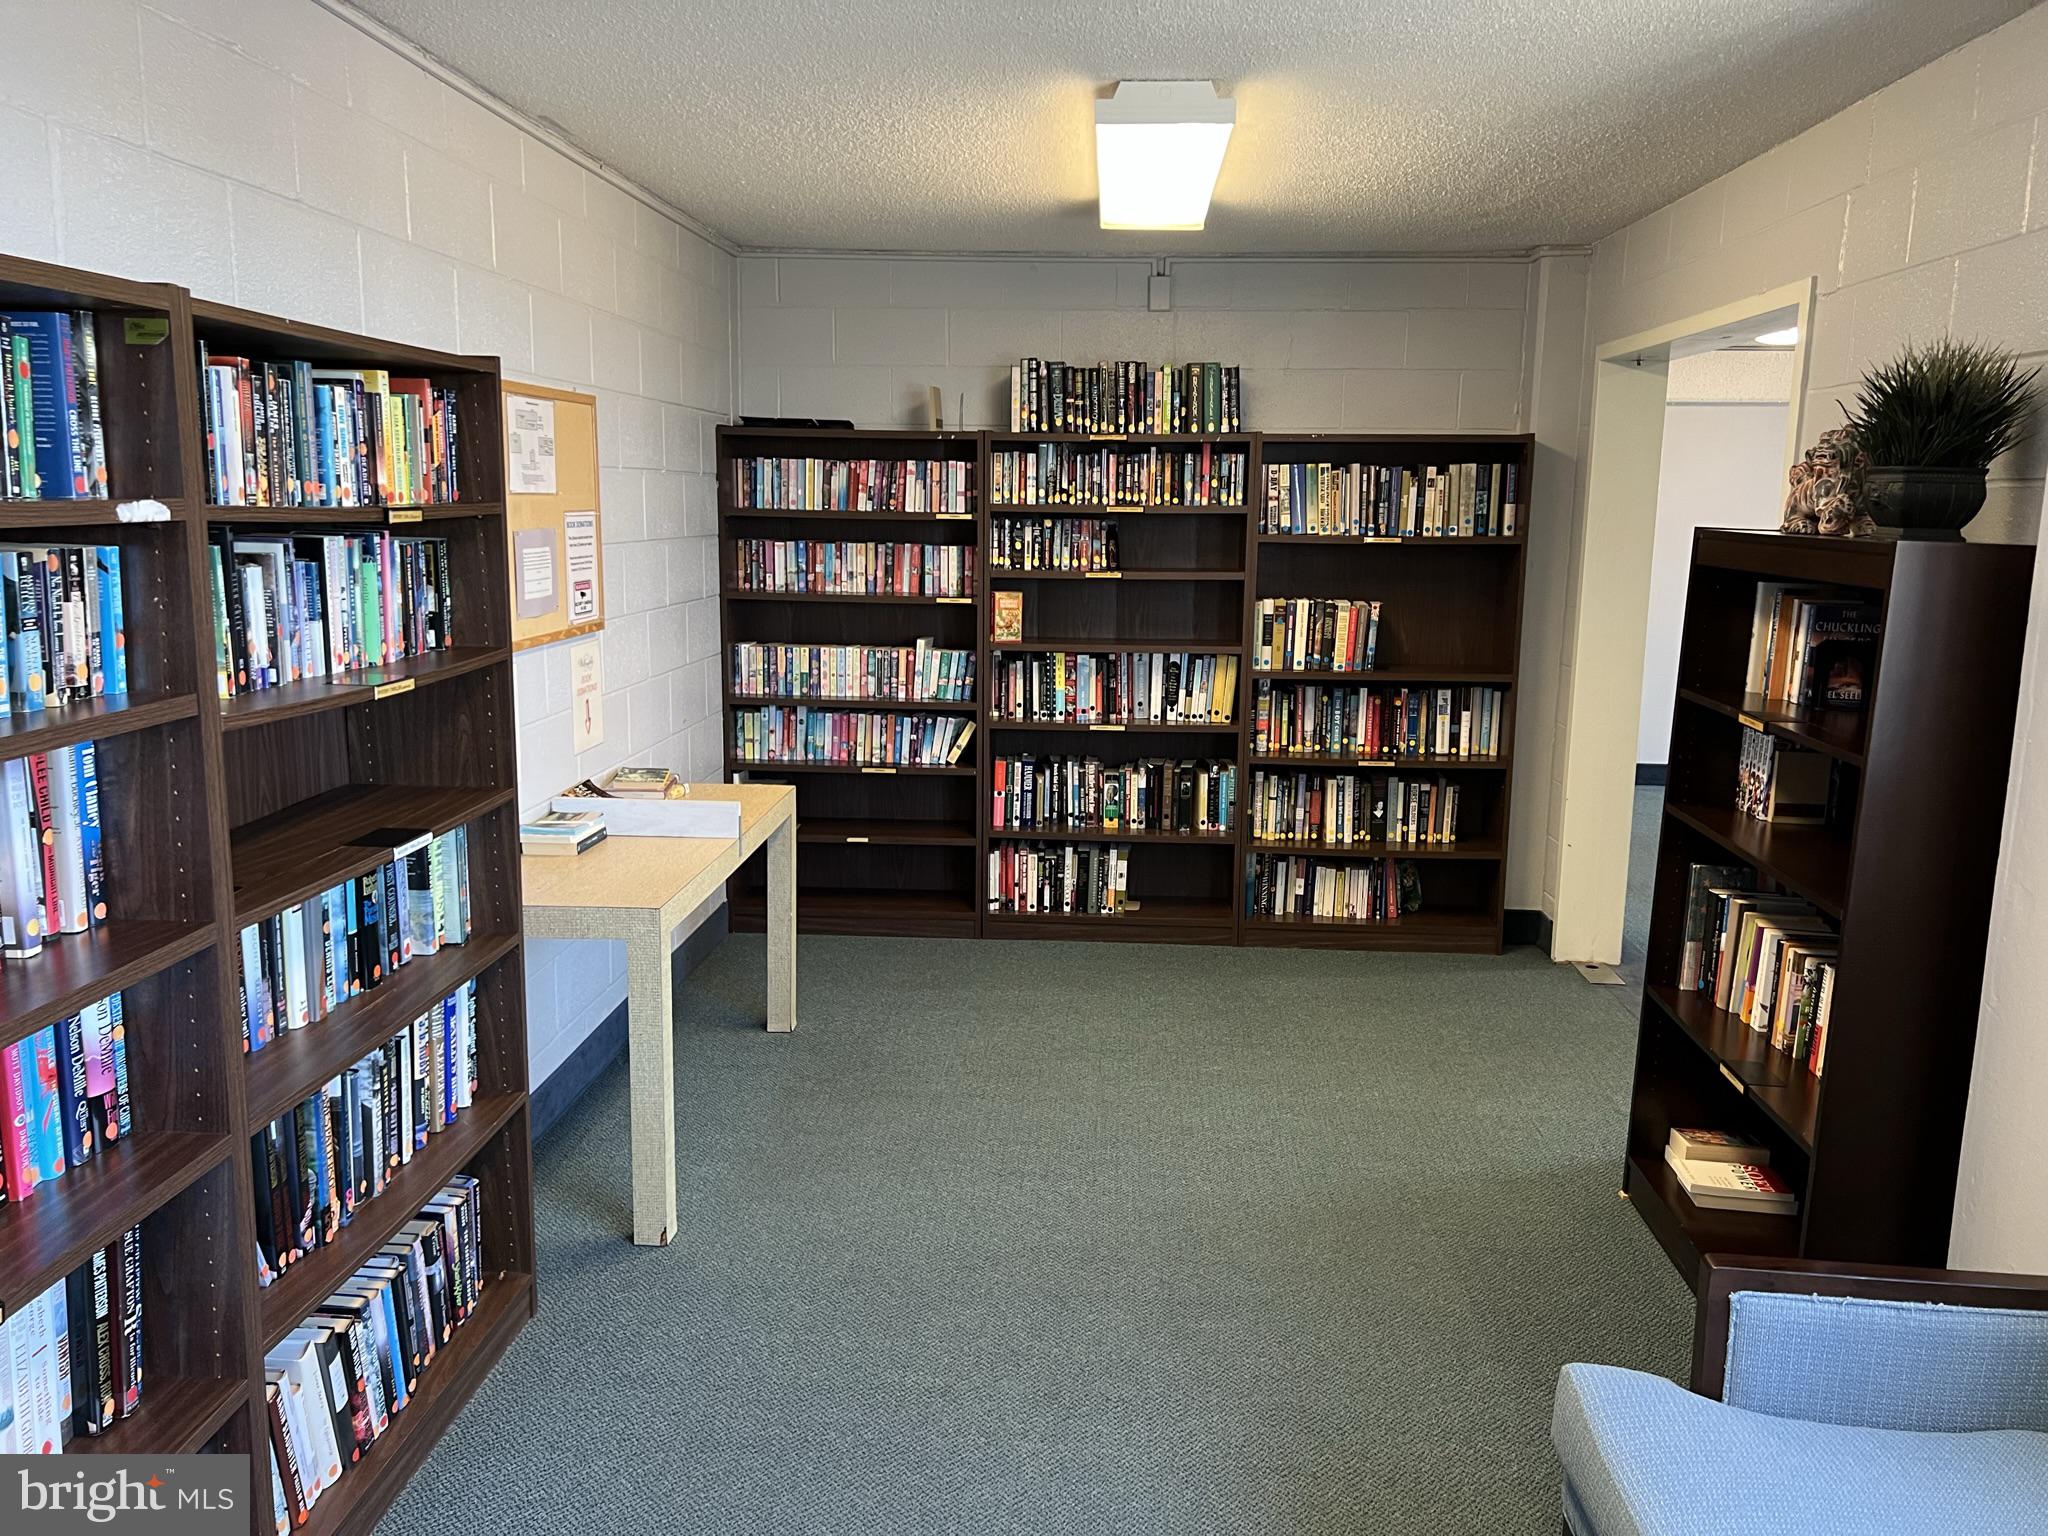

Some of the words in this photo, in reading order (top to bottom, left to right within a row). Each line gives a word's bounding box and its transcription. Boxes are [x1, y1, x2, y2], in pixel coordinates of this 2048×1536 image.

[65, 363, 77, 404] PATTERSON
[68, 409, 79, 437] CROSS
[272, 400, 280, 428] JAMES
[71, 437, 81, 452] THE
[72, 455, 82, 473] LINE
[361, 457, 369, 496] DEADLINE
[28, 575, 37, 609] MATTHEW
[52, 589, 63, 610] Night
[1815, 621, 1880, 634] CHUCKLING
[1842, 610, 1857, 619] THE
[36, 760, 47, 784] LEE
[81, 744, 95, 778] Tom
[39, 785, 51, 823] CHILD
[82, 780, 100, 828] Clancy
[1411, 785, 1419, 804] HORSE
[48, 854, 58, 894] MIDNIGHT
[87, 858, 104, 896] Tiger
[386, 863, 395, 887] FIRST
[51, 895, 59, 914] LINE
[386, 887, 396, 927] COUNSEL
[1261, 876, 1269, 908] WINNING
[324, 940, 333, 974] DENNIS
[112, 998, 122, 1028] DEXTER
[239, 987, 248, 1017] ashley
[68, 1015, 81, 1054] Nelson
[241, 1018, 250, 1039] bell
[11, 1048, 20, 1070] MOTT
[98, 1023, 115, 1076] DeMille
[71, 1054, 87, 1098] DeMille
[115, 1051, 128, 1094] DAUGHTERS
[436, 1042, 445, 1092] SLEEPER
[12, 1072, 24, 1112] DAVIDSON
[119, 1094, 129, 1106] OF
[120, 1105, 131, 1126] CAIN
[19, 1129, 27, 1151] DARK
[123, 1230, 134, 1256] SUE
[94, 1272, 108, 1320] PATTERSON
[124, 1256, 136, 1315] GRAFTON
[453, 1285, 463, 1307] River
[28, 1303, 37, 1337] eorge
[37, 1299, 48, 1338] zabeth
[124, 1314, 138, 1337] R
[96, 1321, 109, 1348] ALEX
[129, 1332, 136, 1342] is
[129, 1343, 137, 1356] for
[348, 1324, 358, 1349] BRAD
[57, 1334, 71, 1381] VANISH
[98, 1345, 110, 1384] CROSS,
[351, 1349, 363, 1380] TAYLOR
[15, 1344, 30, 1419] ELIZABETH
[35, 1376, 41, 1386] to
[41, 1360, 53, 1425] Something
[36, 1393, 44, 1421] Hide
[276, 1395, 286, 1425] KARIN
[282, 1423, 297, 1474] SLAUGHTER
[292, 1474, 302, 1494] PIECES
